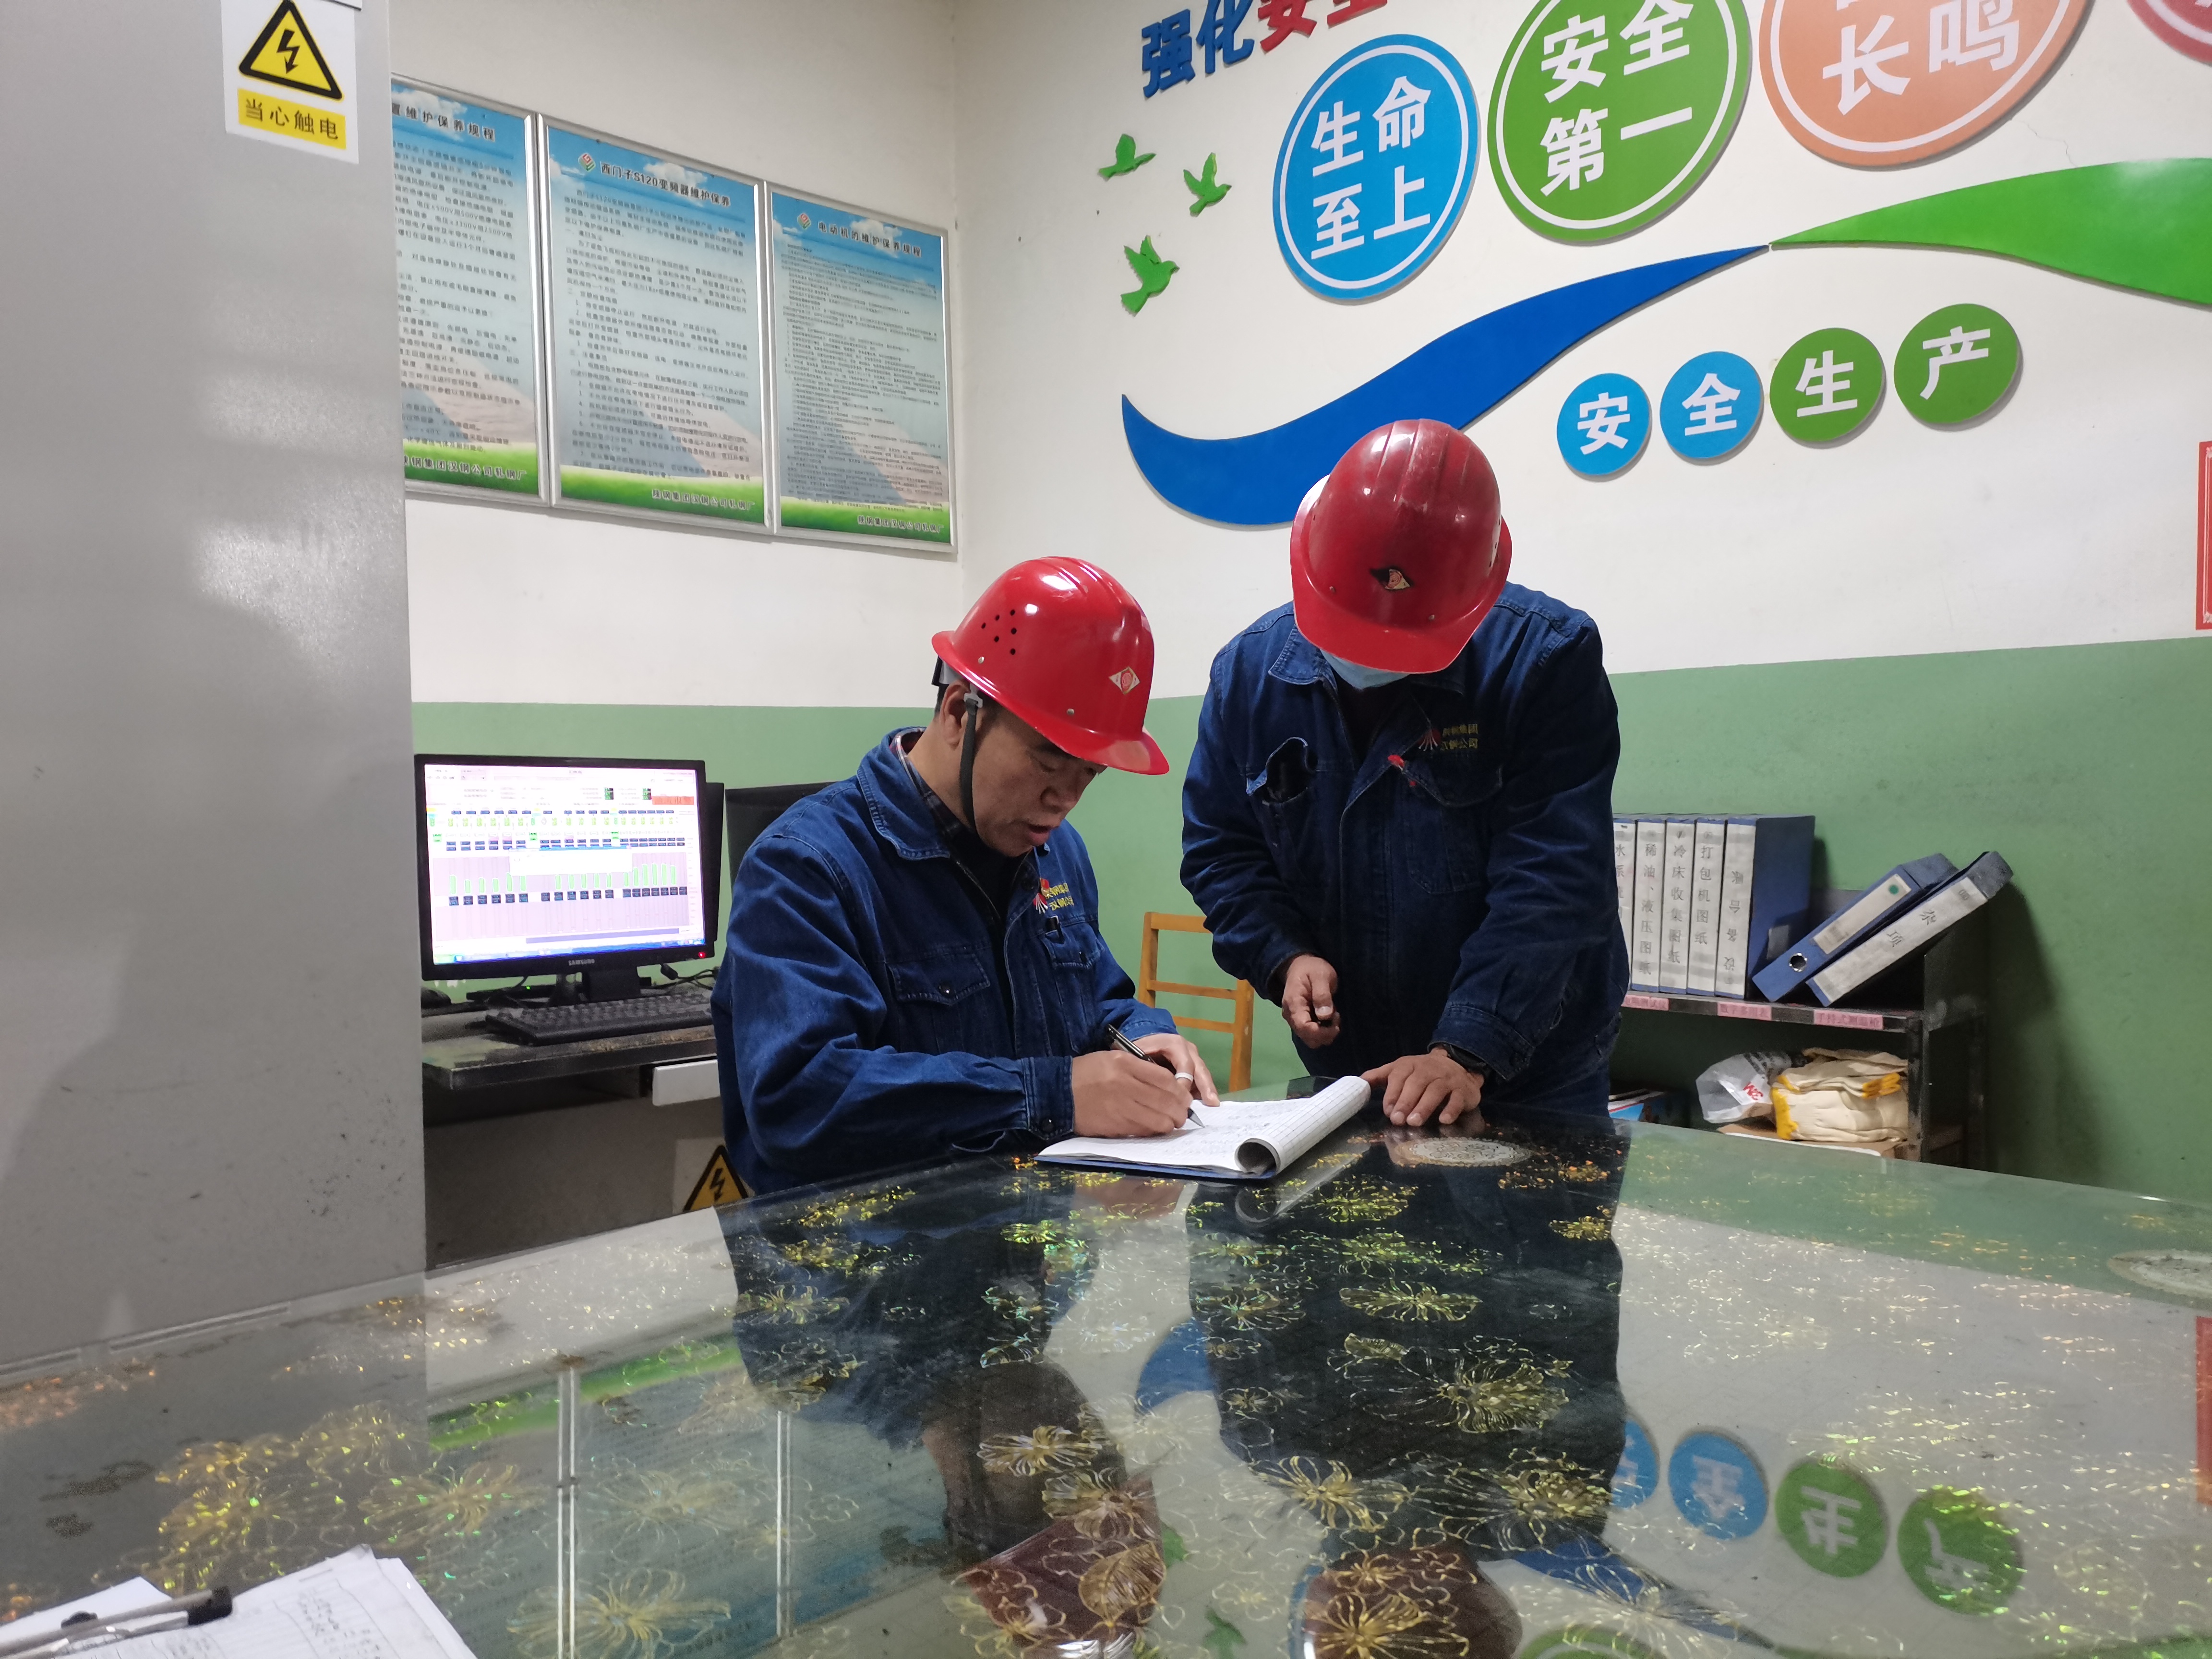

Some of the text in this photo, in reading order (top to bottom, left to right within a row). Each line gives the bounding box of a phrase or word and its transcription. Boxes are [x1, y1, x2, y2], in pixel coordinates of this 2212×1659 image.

[1142, 0, 1387, 98] 强化安
[1541, 0, 1693, 103] 安全
[1822, 0, 2019, 116] 长鸣
[246, 98, 338, 140] 当心触电
[1311, 76, 1431, 177] 生命
[1540, 107, 1692, 196] 第一
[1311, 166, 1431, 259] 至上
[1577, 326, 1991, 455] 安全生产
[1639, 843, 1657, 975] 稀油、液压图纸
[1668, 845, 1687, 964] 冷床收集图纸
[1695, 845, 1714, 945] 打包机图纸
